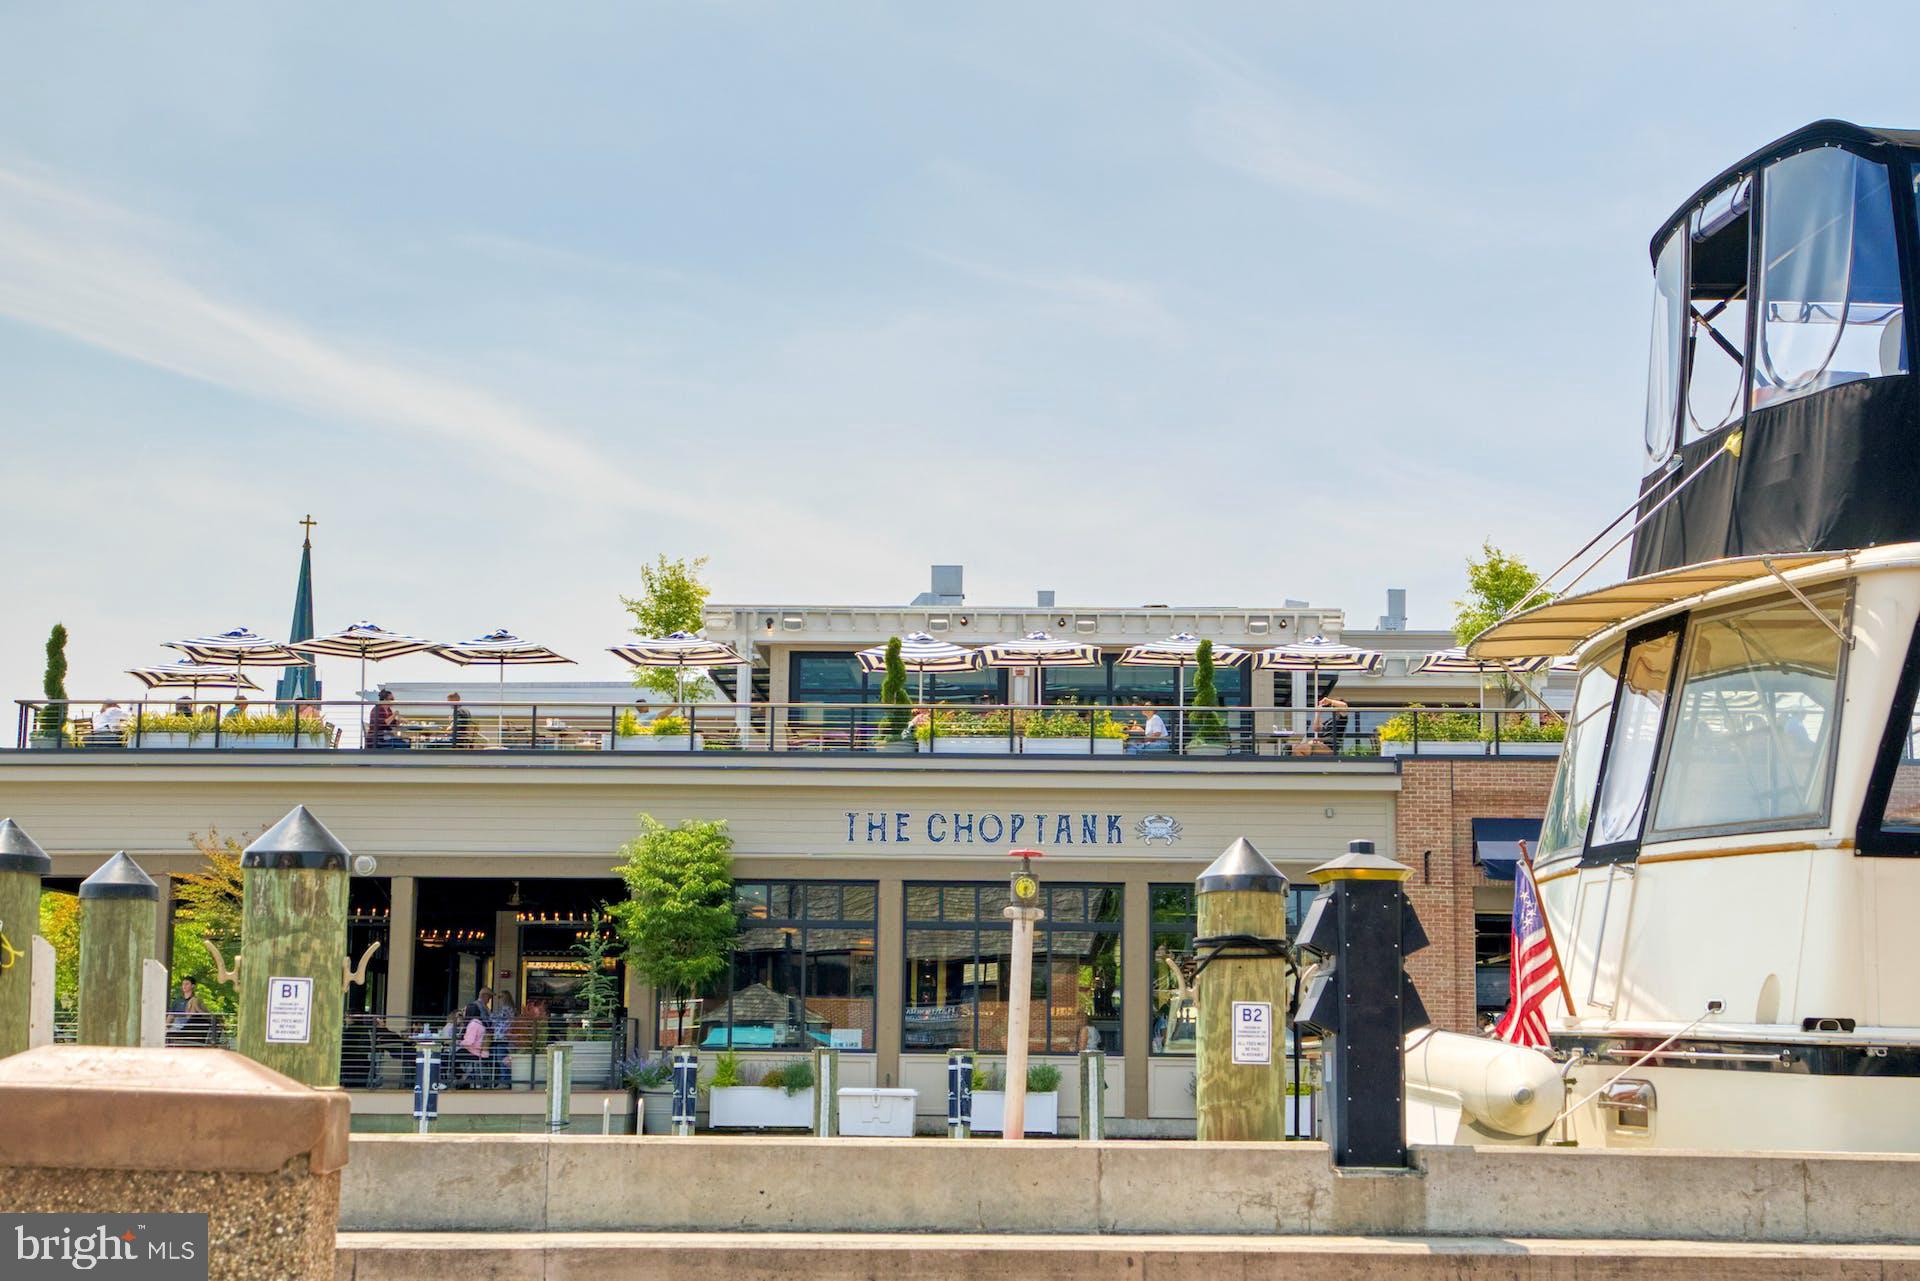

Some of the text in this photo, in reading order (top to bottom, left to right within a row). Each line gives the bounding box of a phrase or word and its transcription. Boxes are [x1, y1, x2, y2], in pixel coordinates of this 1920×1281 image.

[845, 812, 1123, 844] THE CHOPTANK
[282, 984, 298, 998] B1
[1243, 1008, 1262, 1022] B2
